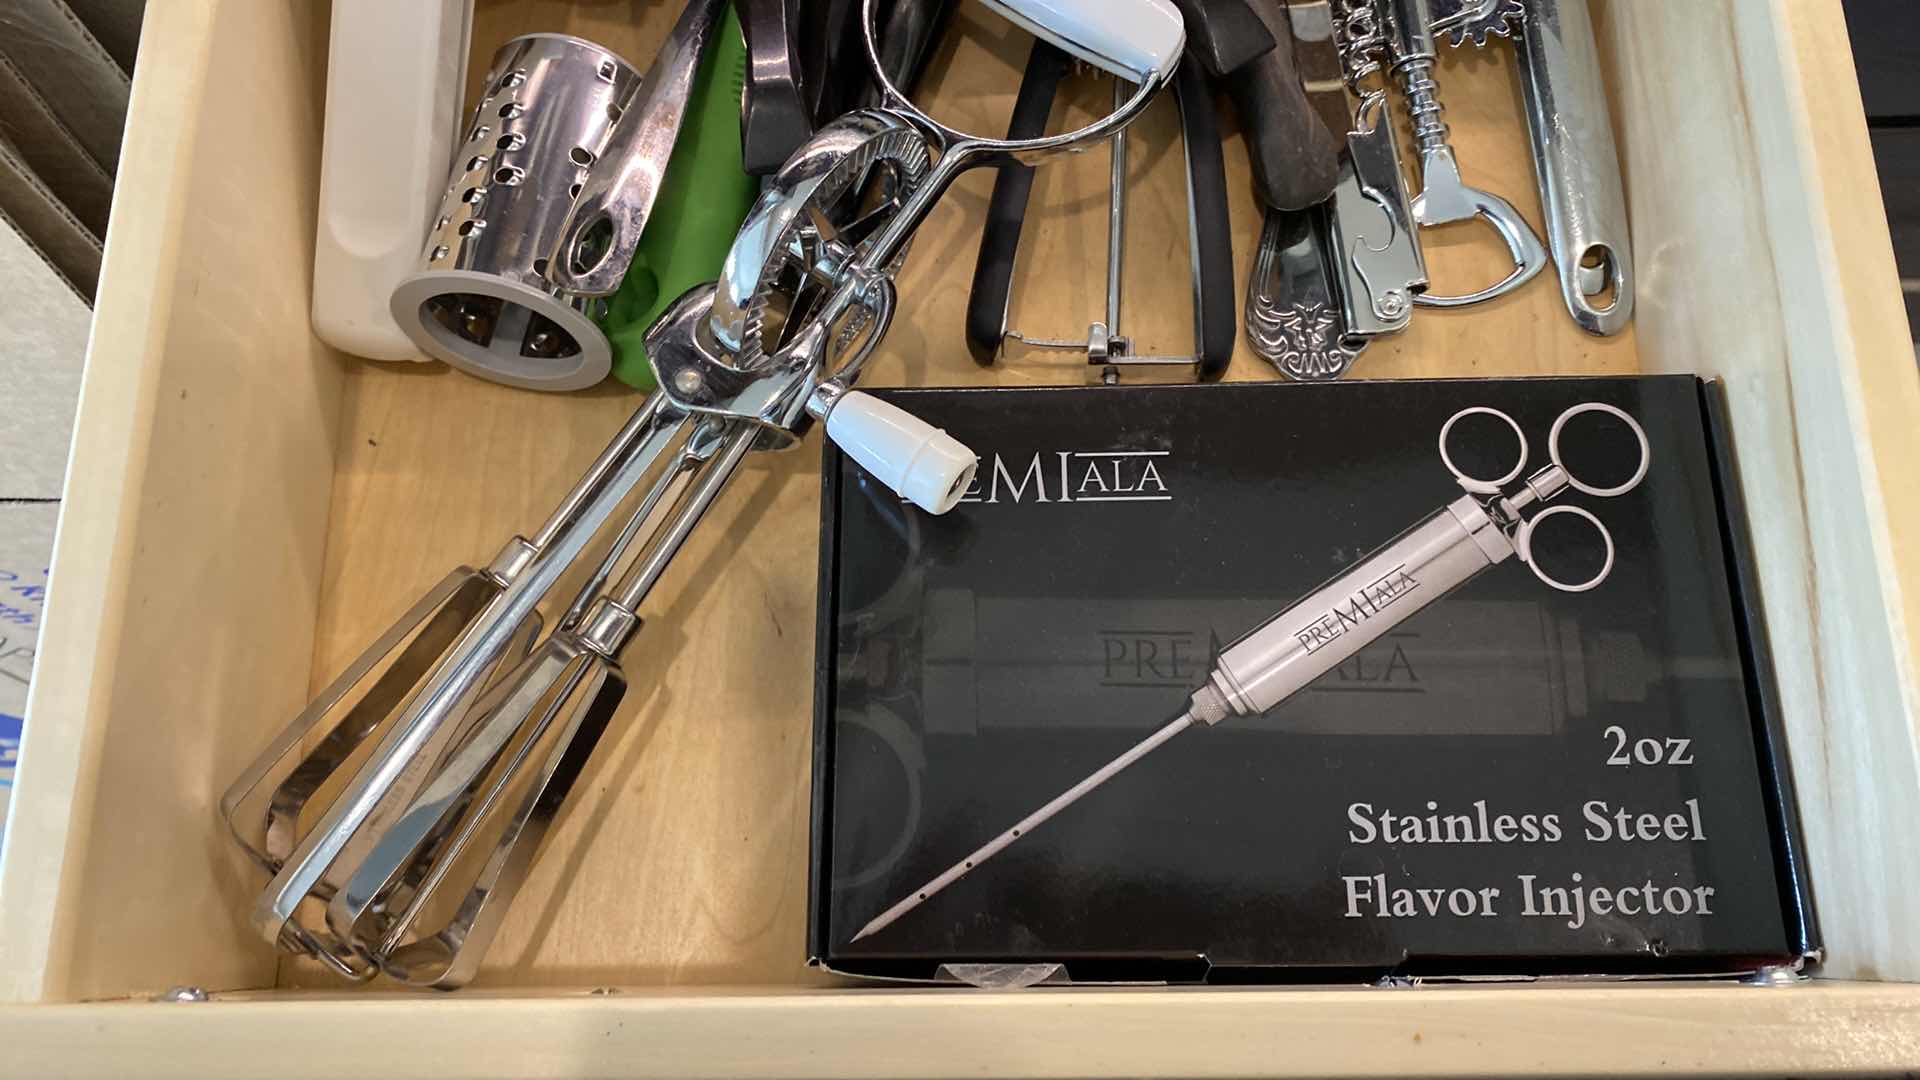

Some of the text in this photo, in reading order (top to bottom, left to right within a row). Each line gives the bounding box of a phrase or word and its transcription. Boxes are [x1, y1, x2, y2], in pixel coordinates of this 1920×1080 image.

[966, 450, 1168, 504] MIALA
[1297, 570, 1418, 653] PREMIALA
[1603, 725, 1695, 766] 2oz
[1346, 799, 1708, 844] Stainless Steel
[1341, 872, 1715, 929] Flavor Injector
